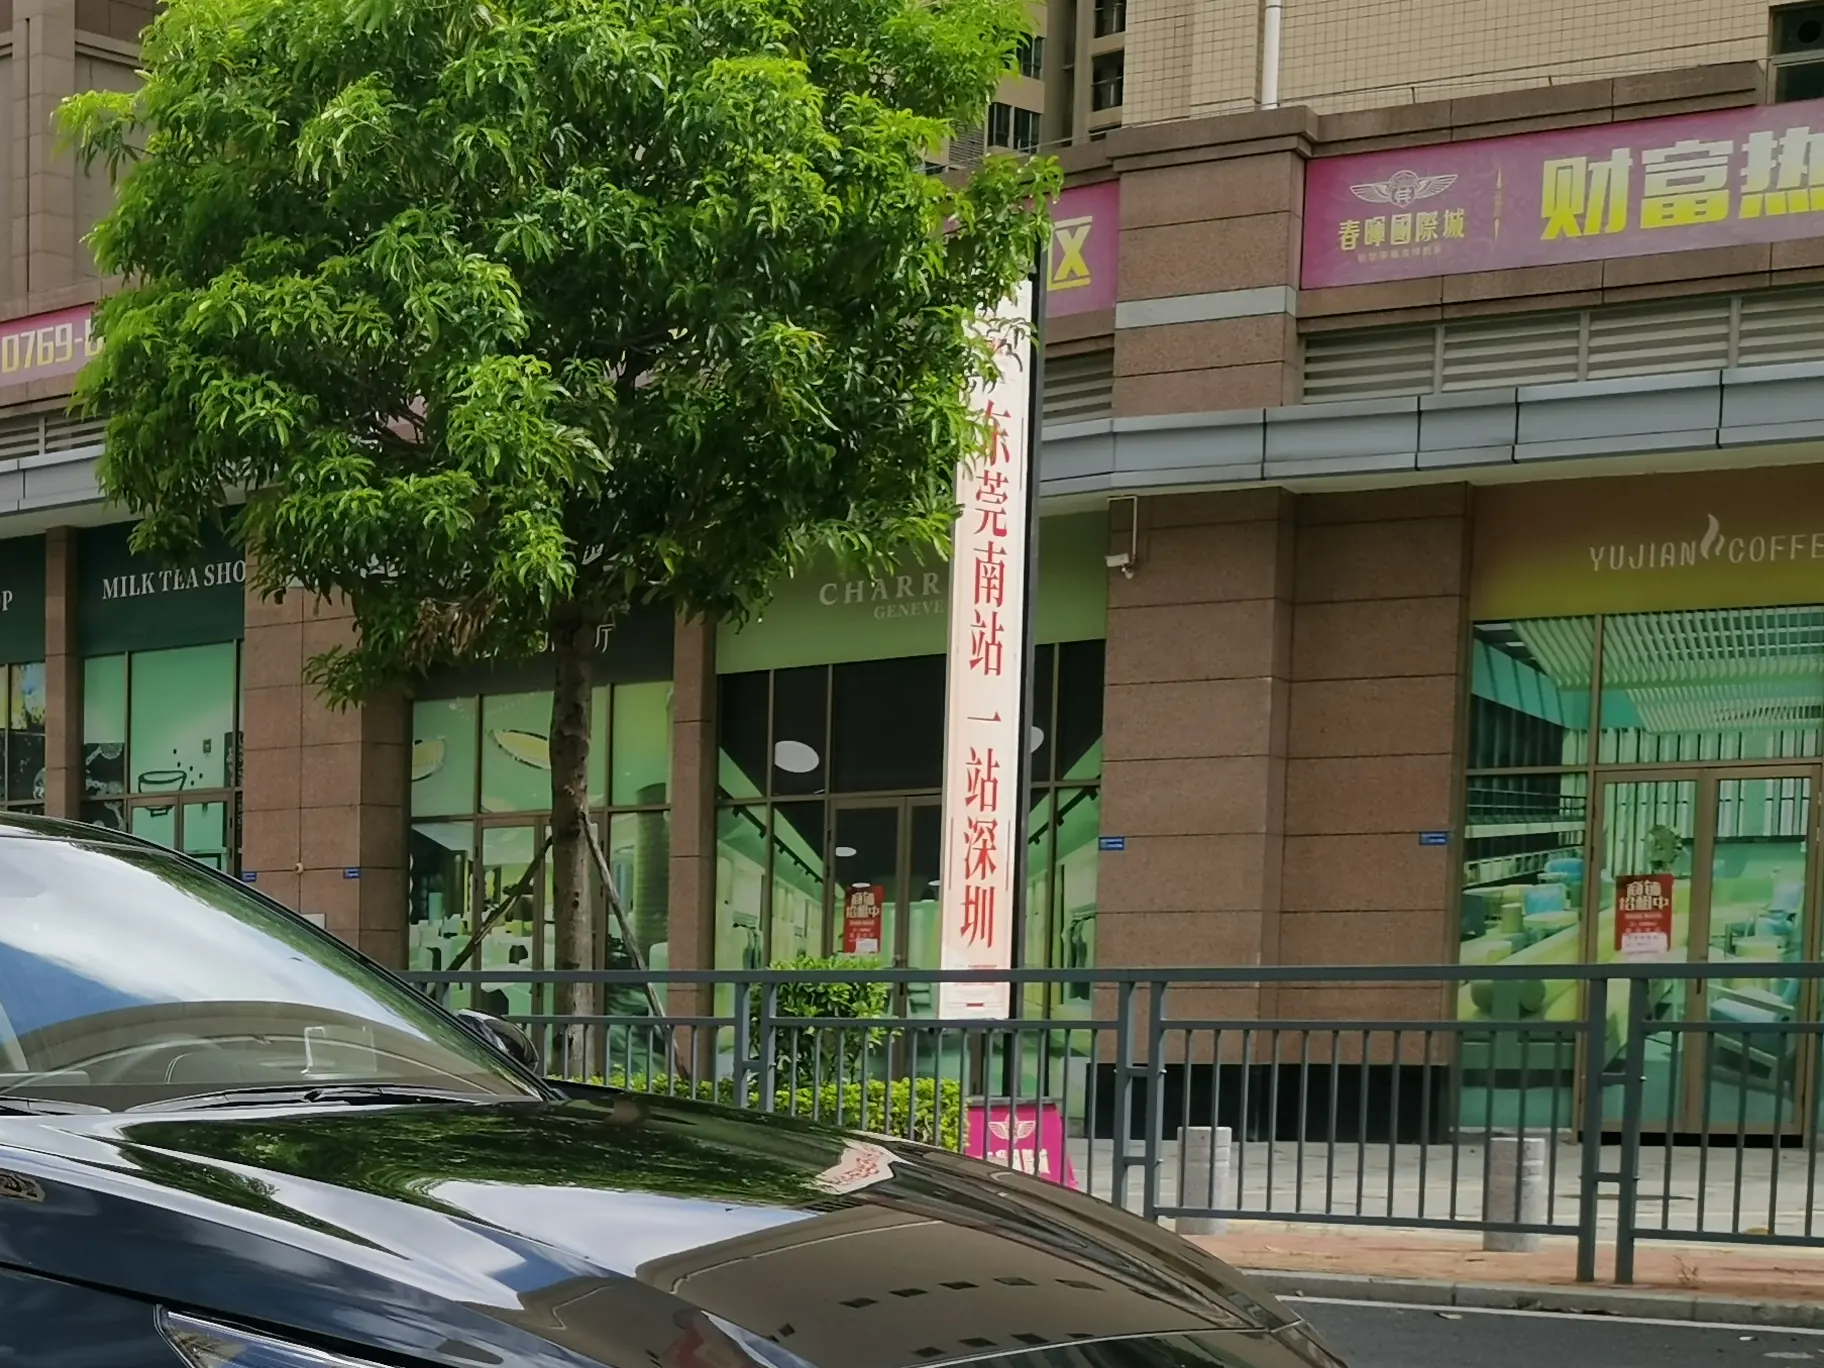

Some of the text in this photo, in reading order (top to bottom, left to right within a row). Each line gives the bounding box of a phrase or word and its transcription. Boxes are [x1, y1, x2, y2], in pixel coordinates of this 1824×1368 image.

[1540, 125, 1824, 240] 财富热
[1589, 540, 1697, 571] YUJIAN
[102, 572, 154, 600] MILK
[158, 565, 199, 592] TEA
